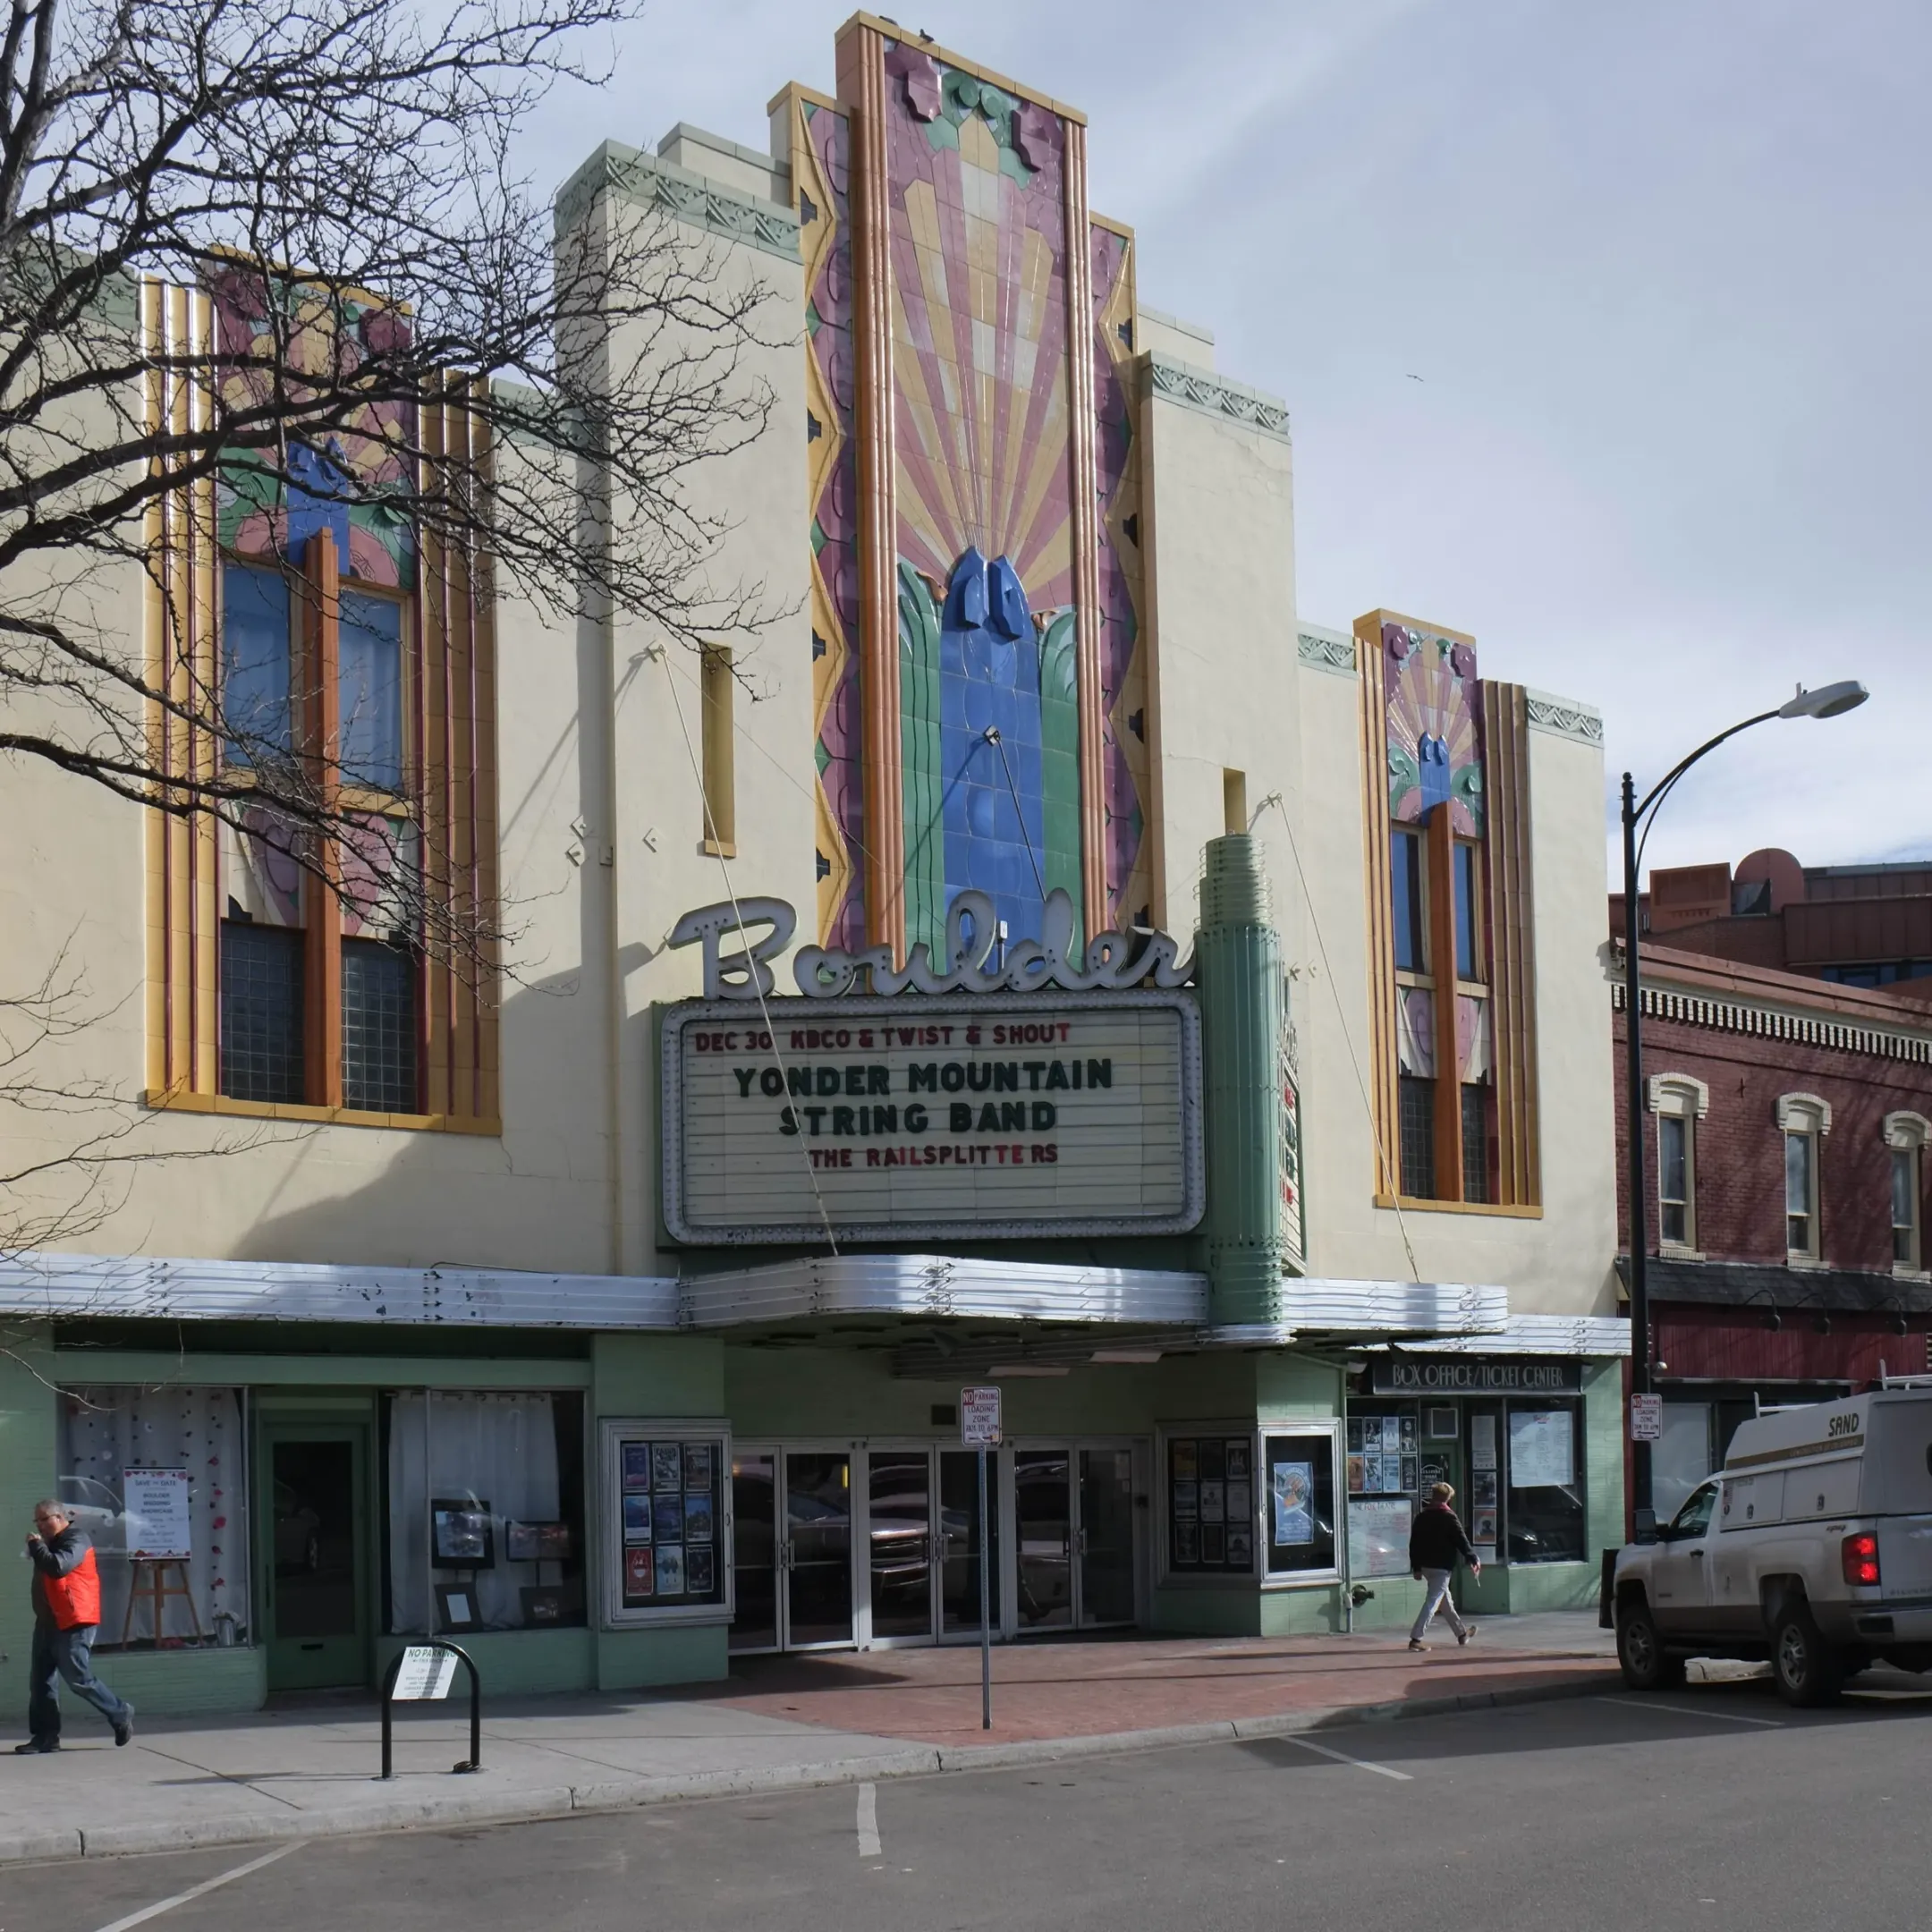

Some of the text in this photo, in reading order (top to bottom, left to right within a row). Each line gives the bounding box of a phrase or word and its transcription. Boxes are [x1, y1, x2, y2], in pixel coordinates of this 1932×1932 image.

[665, 888, 1196, 1000] Boulder
[695, 1022, 1071, 1052] DEC 30 KBCO & TWIST & SHOUT
[733, 1058, 1113, 1097] YONDER MOUNTAIN
[779, 1101, 1057, 1136] STRING BAND
[809, 1143, 1058, 1168] THE RAILSPLITTERS
[1393, 1364, 1421, 1386] BOX
[1522, 1366, 1563, 1385] CENTER
[963, 1392, 998, 1403] NO PARKING
[968, 1405, 995, 1413] LOADING
[1633, 1397, 1641, 1406] NO
[972, 1415, 990, 1423] ZONE
[1828, 1412, 1860, 1437] SAND
[407, 1648, 455, 1657] NO PARKING
